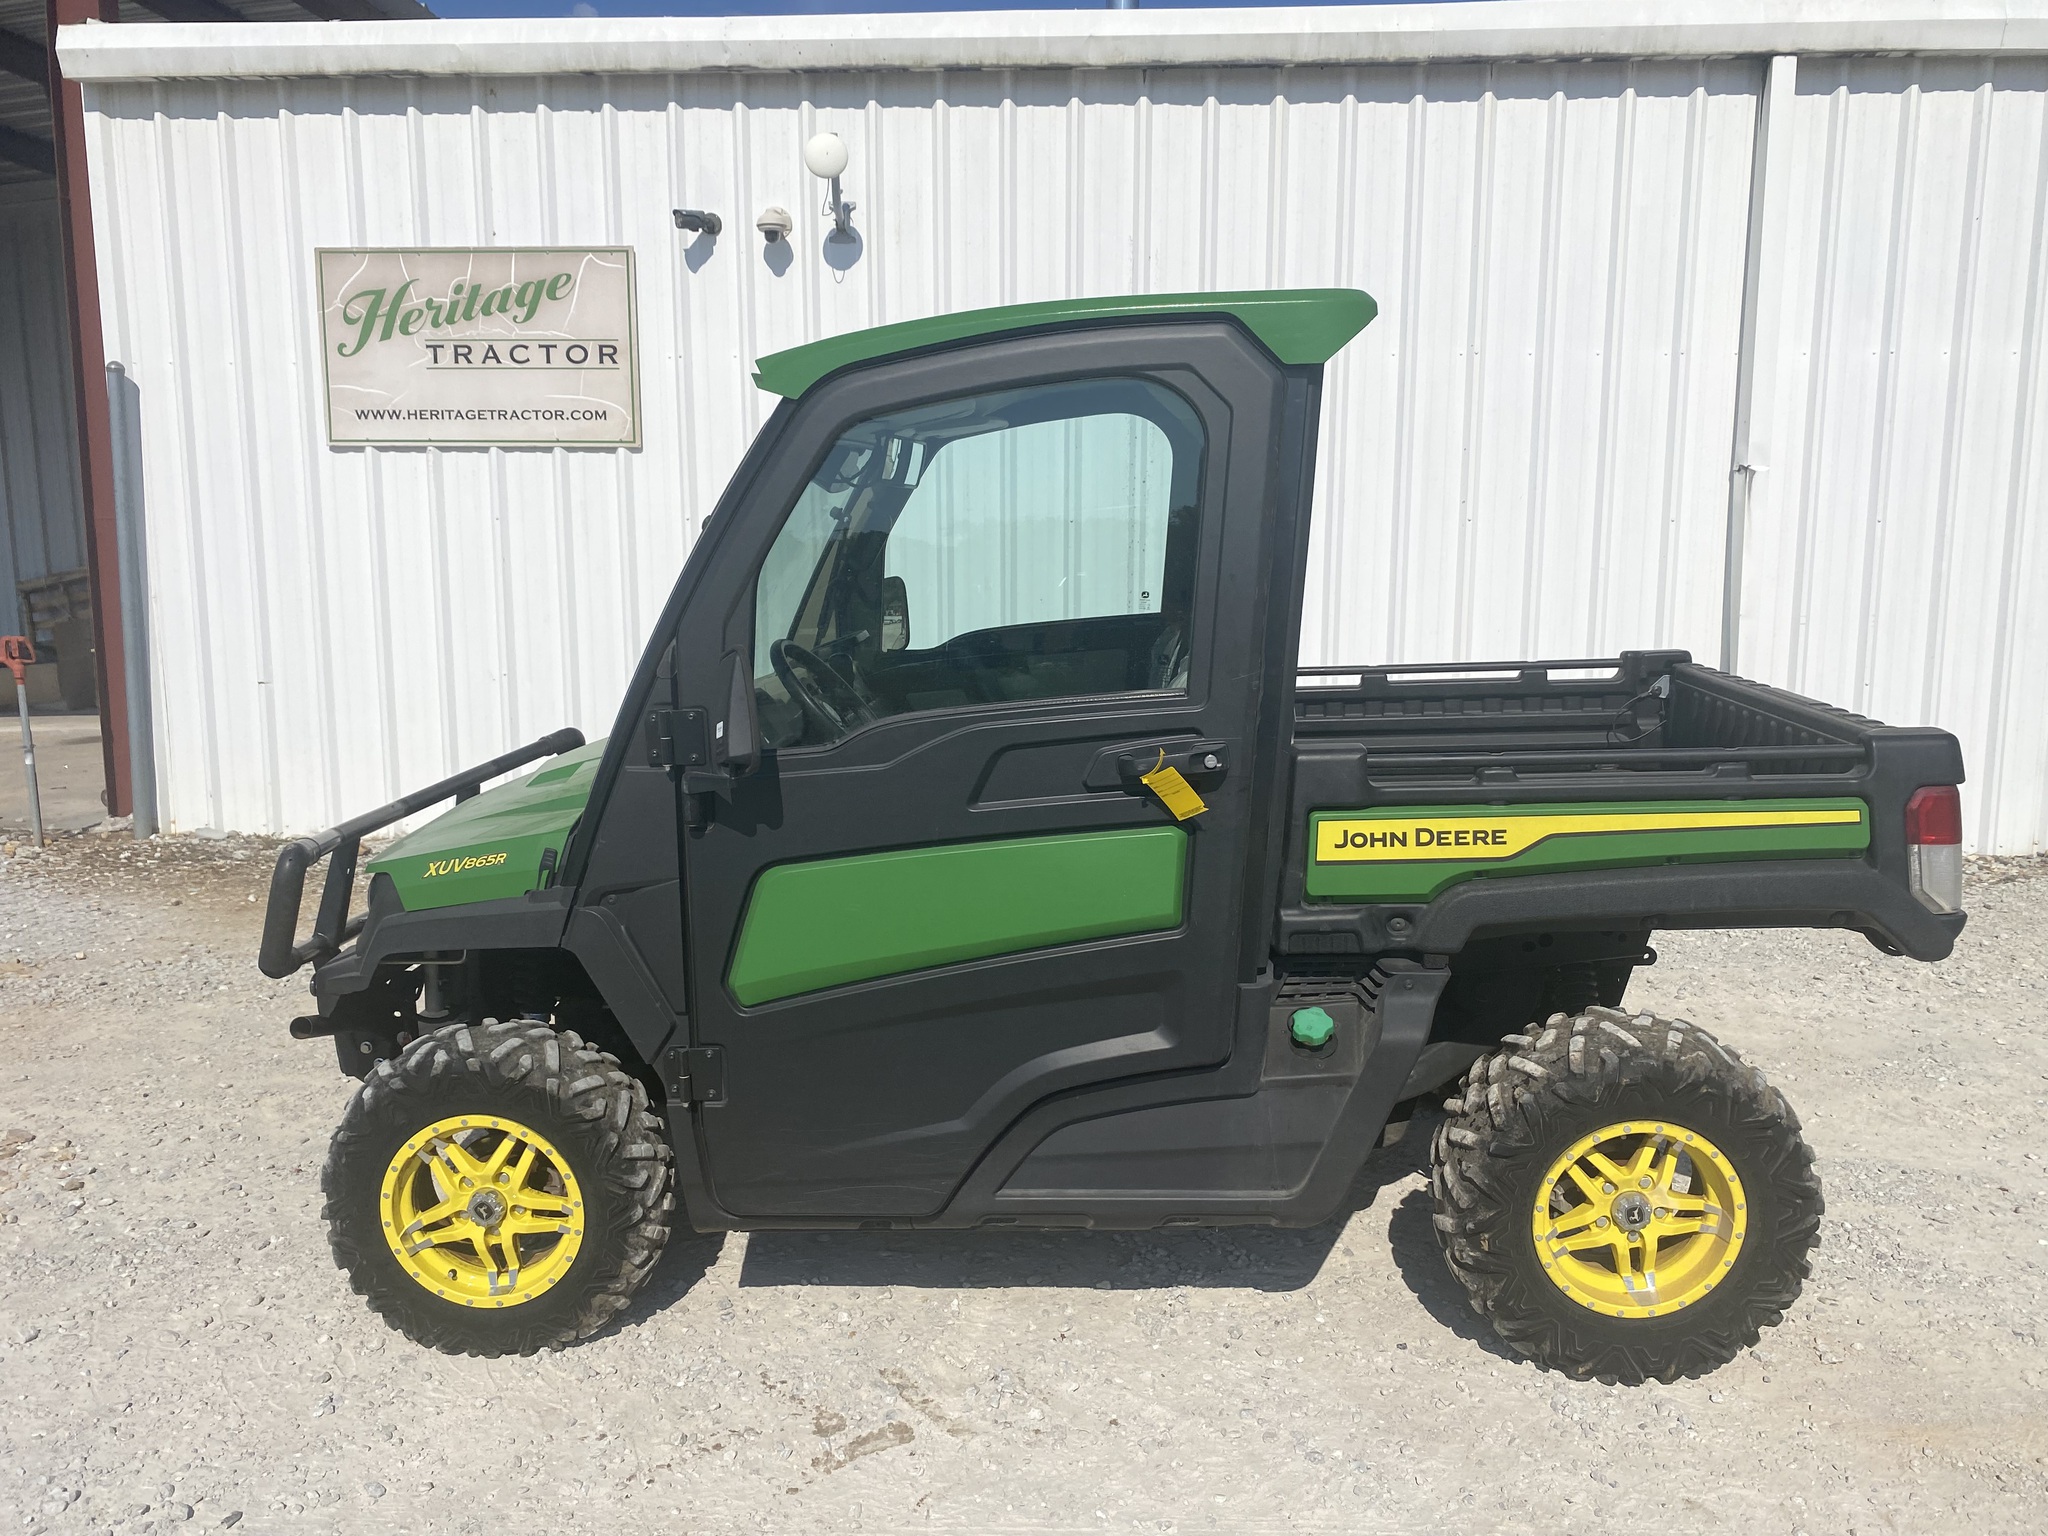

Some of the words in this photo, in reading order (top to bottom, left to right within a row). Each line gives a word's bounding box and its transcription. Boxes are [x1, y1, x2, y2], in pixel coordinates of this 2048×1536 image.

[337, 273, 577, 357] Heritage
[425, 344, 618, 364] TRACTOR
[355, 410, 607, 421] WWW.HERITAGETRACTOR.COM
[1334, 830, 1407, 848] JOHN
[1415, 828, 1507, 846] DEERE
[422, 852, 507, 878] XUV865R
